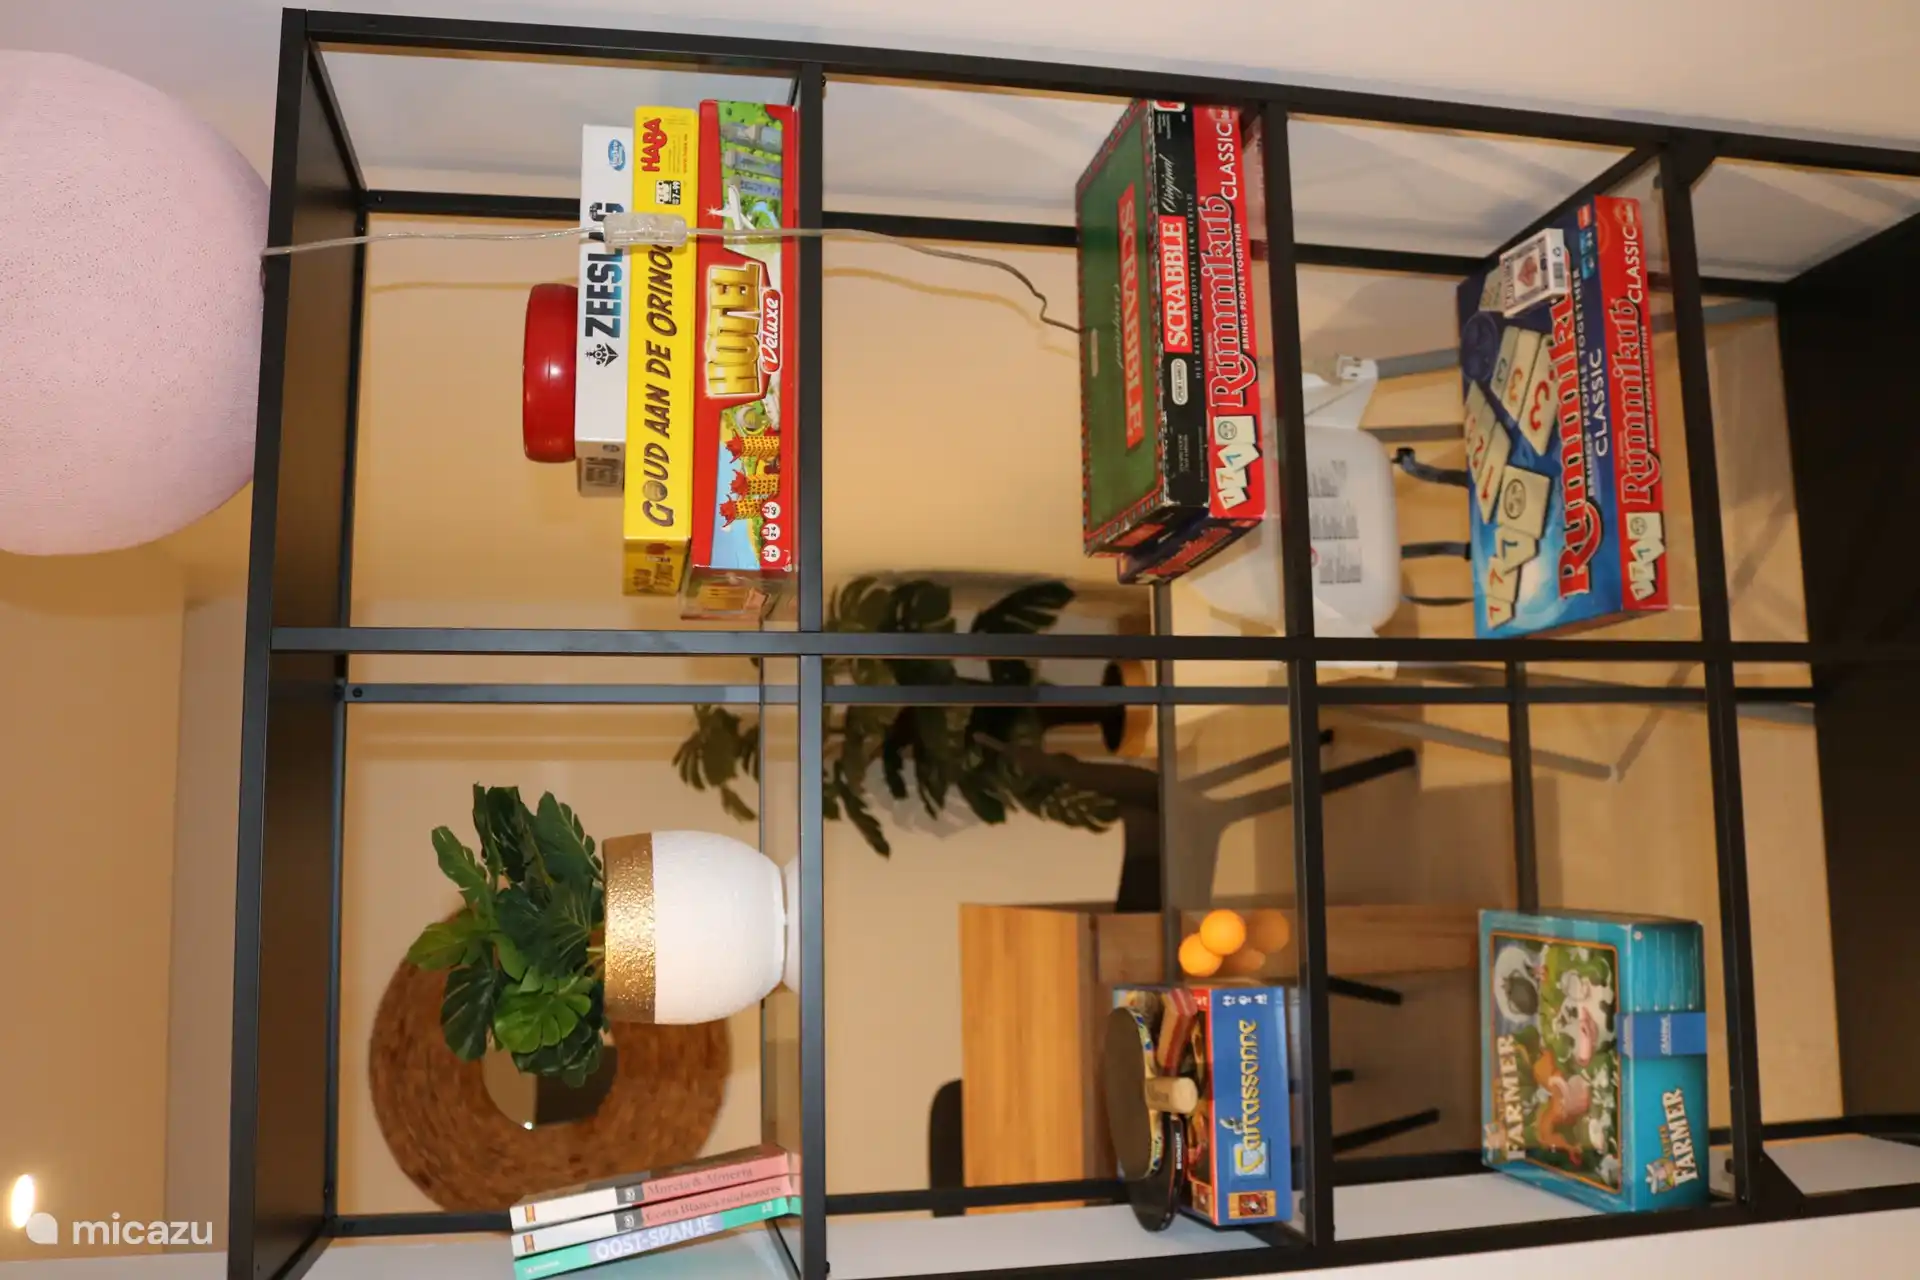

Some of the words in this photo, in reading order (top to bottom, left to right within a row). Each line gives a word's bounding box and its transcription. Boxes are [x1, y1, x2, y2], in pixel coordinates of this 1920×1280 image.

[640, 118, 668, 172] HABA
[1159, 152, 1184, 213] Original
[1215, 123, 1238, 200] CLASSIC
[1160, 221, 1189, 347] SCRABBLE
[1233, 222, 1245, 273] TOGETHER
[1622, 226, 1645, 304] CLASSIC
[704, 262, 761, 396] HOTEL
[760, 297, 779, 364] Deluxe
[1118, 200, 1144, 432] SCRABBLE
[1198, 195, 1257, 407] Rummikub
[1238, 275, 1248, 311] PEOPLE
[1239, 312, 1250, 349] BRINGS
[1572, 268, 1586, 358] TOGETHER
[645, 340, 671, 379] DE
[1579, 364, 1591, 426] PEOPLE
[644, 383, 671, 439] AAN
[1528, 380, 1550, 431] 3
[1546, 246, 1603, 598] Rummiku
[1589, 348, 1609, 457] CLASSIC
[1608, 297, 1661, 504] Rummikub
[642, 442, 674, 527] GOUD
[1226, 453, 1242, 466] 7
[1489, 605, 1501, 620] 7
[1501, 539, 1519, 559] 7
[1235, 1019, 1265, 1172] Carcassonne
[1496, 1033, 1527, 1161] FARMER
[1661, 1087, 1699, 1184] FARMER
[595, 1215, 715, 1259] OOST-SPANJE
